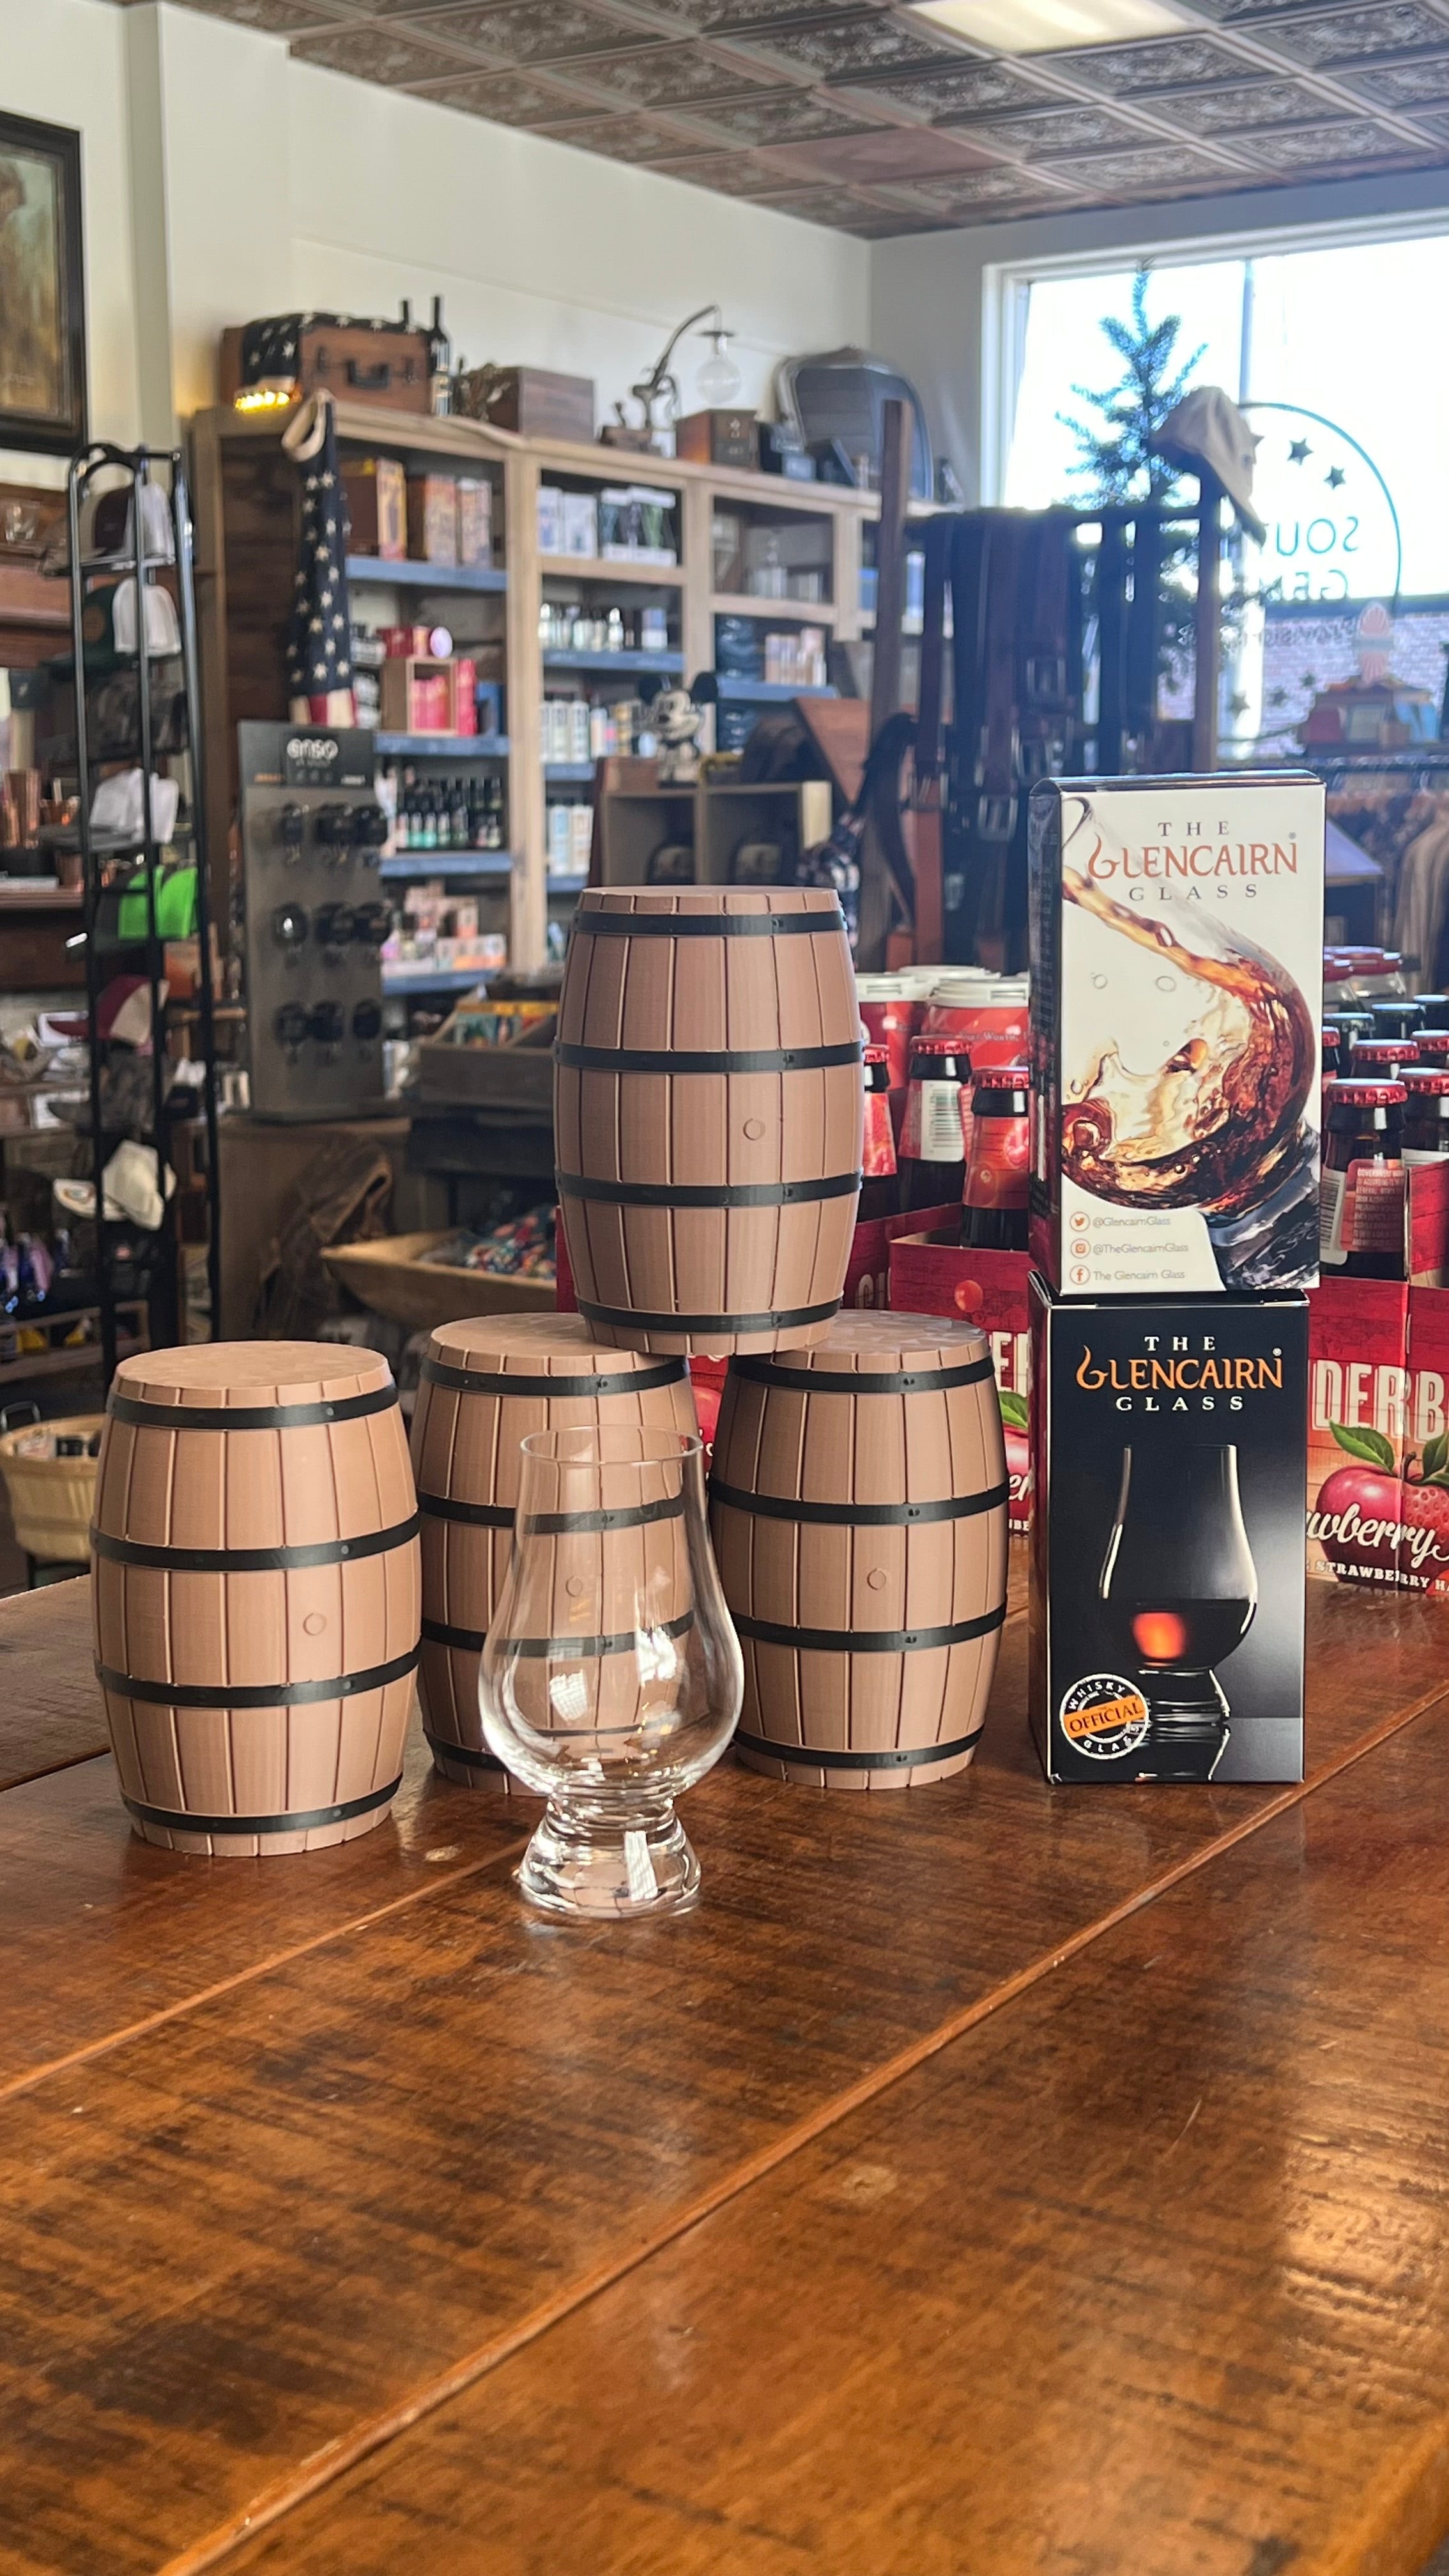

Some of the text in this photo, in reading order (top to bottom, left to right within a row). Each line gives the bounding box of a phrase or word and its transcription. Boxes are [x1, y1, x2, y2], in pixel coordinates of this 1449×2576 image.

[1158, 820, 1230, 836] THE
[1087, 833, 1298, 880] GLENCAIRN
[1129, 884, 1258, 901] GLASS
[1094, 1271, 1112, 1280] The
[1161, 1269, 1185, 1279] Glass
[1144, 1336, 1215, 1351] THE
[1076, 1345, 1283, 1390] GLENCAIRN
[1116, 1396, 1243, 1411] GLASS
[1316, 1560, 1449, 1592] STRAWBERRY H
[1068, 1681, 1126, 1710] WHISKY
[1070, 1702, 1144, 1732] OFFICIAL
[1084, 1726, 1140, 1752] GLASS
